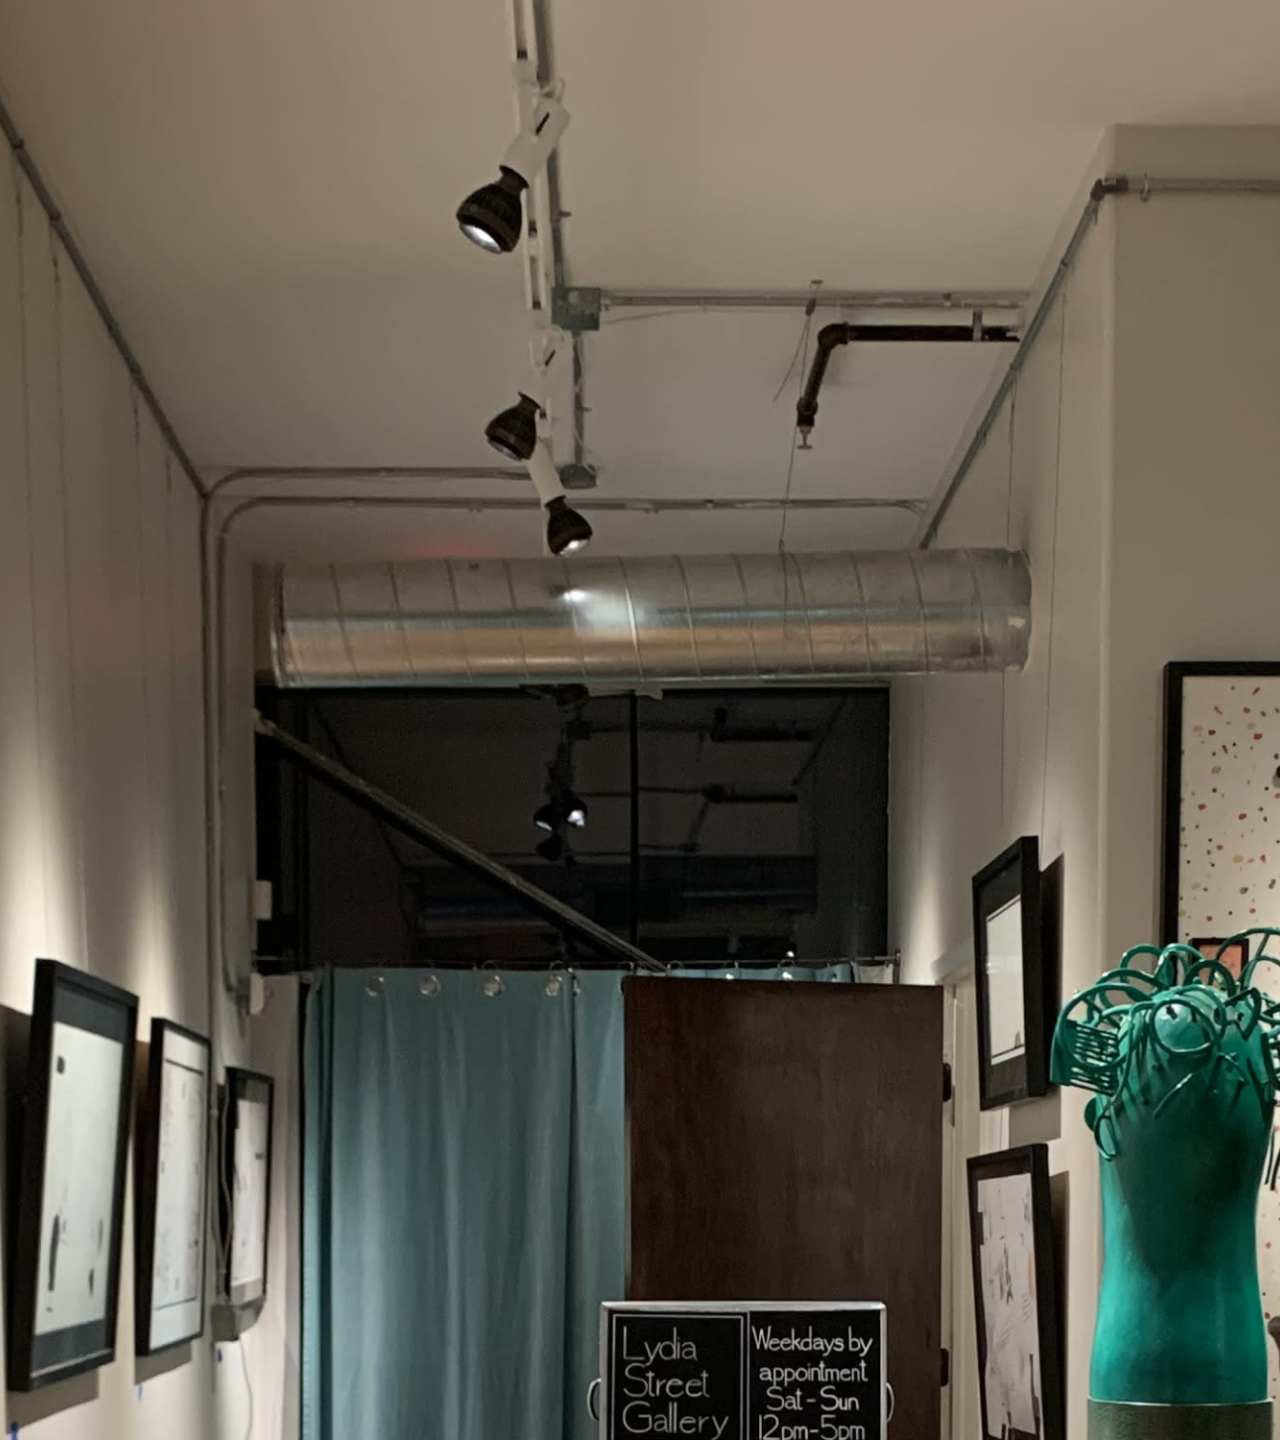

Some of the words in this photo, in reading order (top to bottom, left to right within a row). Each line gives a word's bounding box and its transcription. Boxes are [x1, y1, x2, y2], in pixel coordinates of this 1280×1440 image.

[622, 1326, 698, 1366] Lydia
[751, 1326, 844, 1357] Weekdays
[848, 1326, 873, 1357] by
[623, 1362, 710, 1398] Street
[759, 1360, 869, 1389] appointment
[766, 1386, 803, 1411] Sat
[820, 1385, 860, 1411] Sun
[622, 1400, 729, 1440] Gallery
